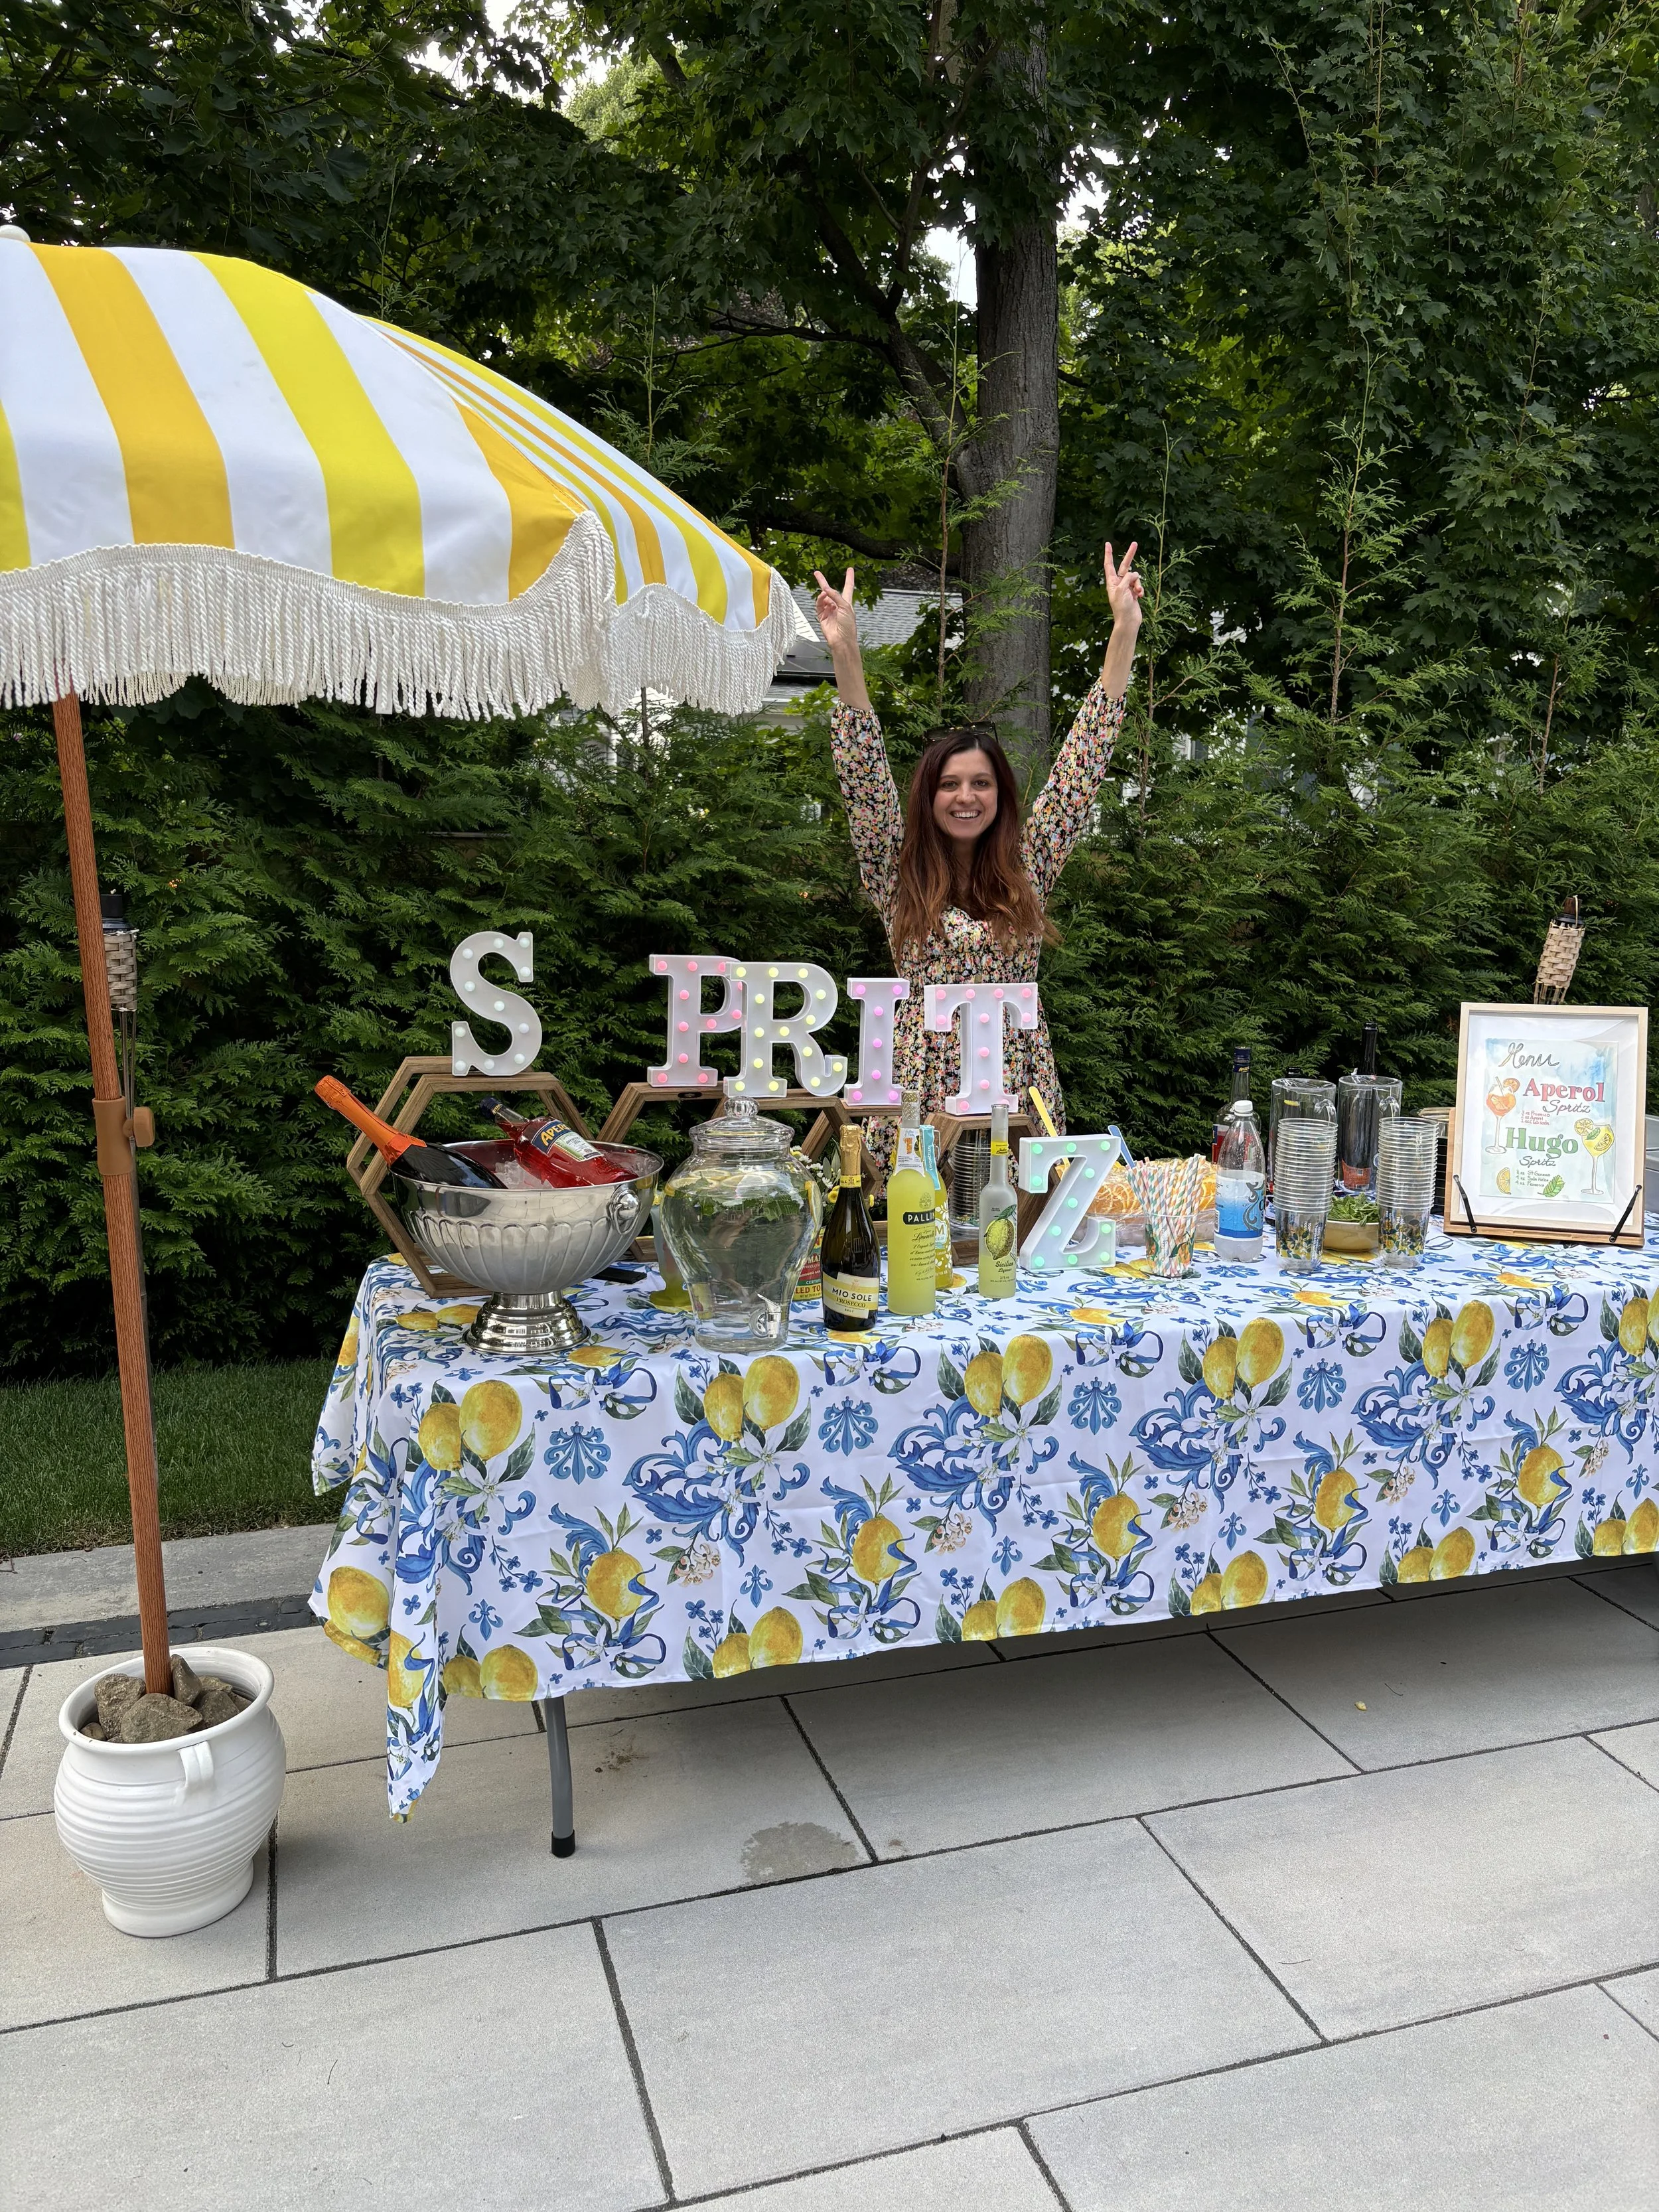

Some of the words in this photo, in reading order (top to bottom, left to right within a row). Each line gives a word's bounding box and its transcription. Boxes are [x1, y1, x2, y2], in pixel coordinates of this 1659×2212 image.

[1498, 1042, 1560, 1069] Menu
[1522, 1078, 1605, 1102] Aperol
[1542, 1100, 1591, 1116] Spritz
[1505, 1127, 1579, 1159] Hugo
[1519, 1155, 1557, 1168] Spritz
[832, 1288, 849, 1298] MIO
[836, 1297, 866, 1308] PROSECCO
